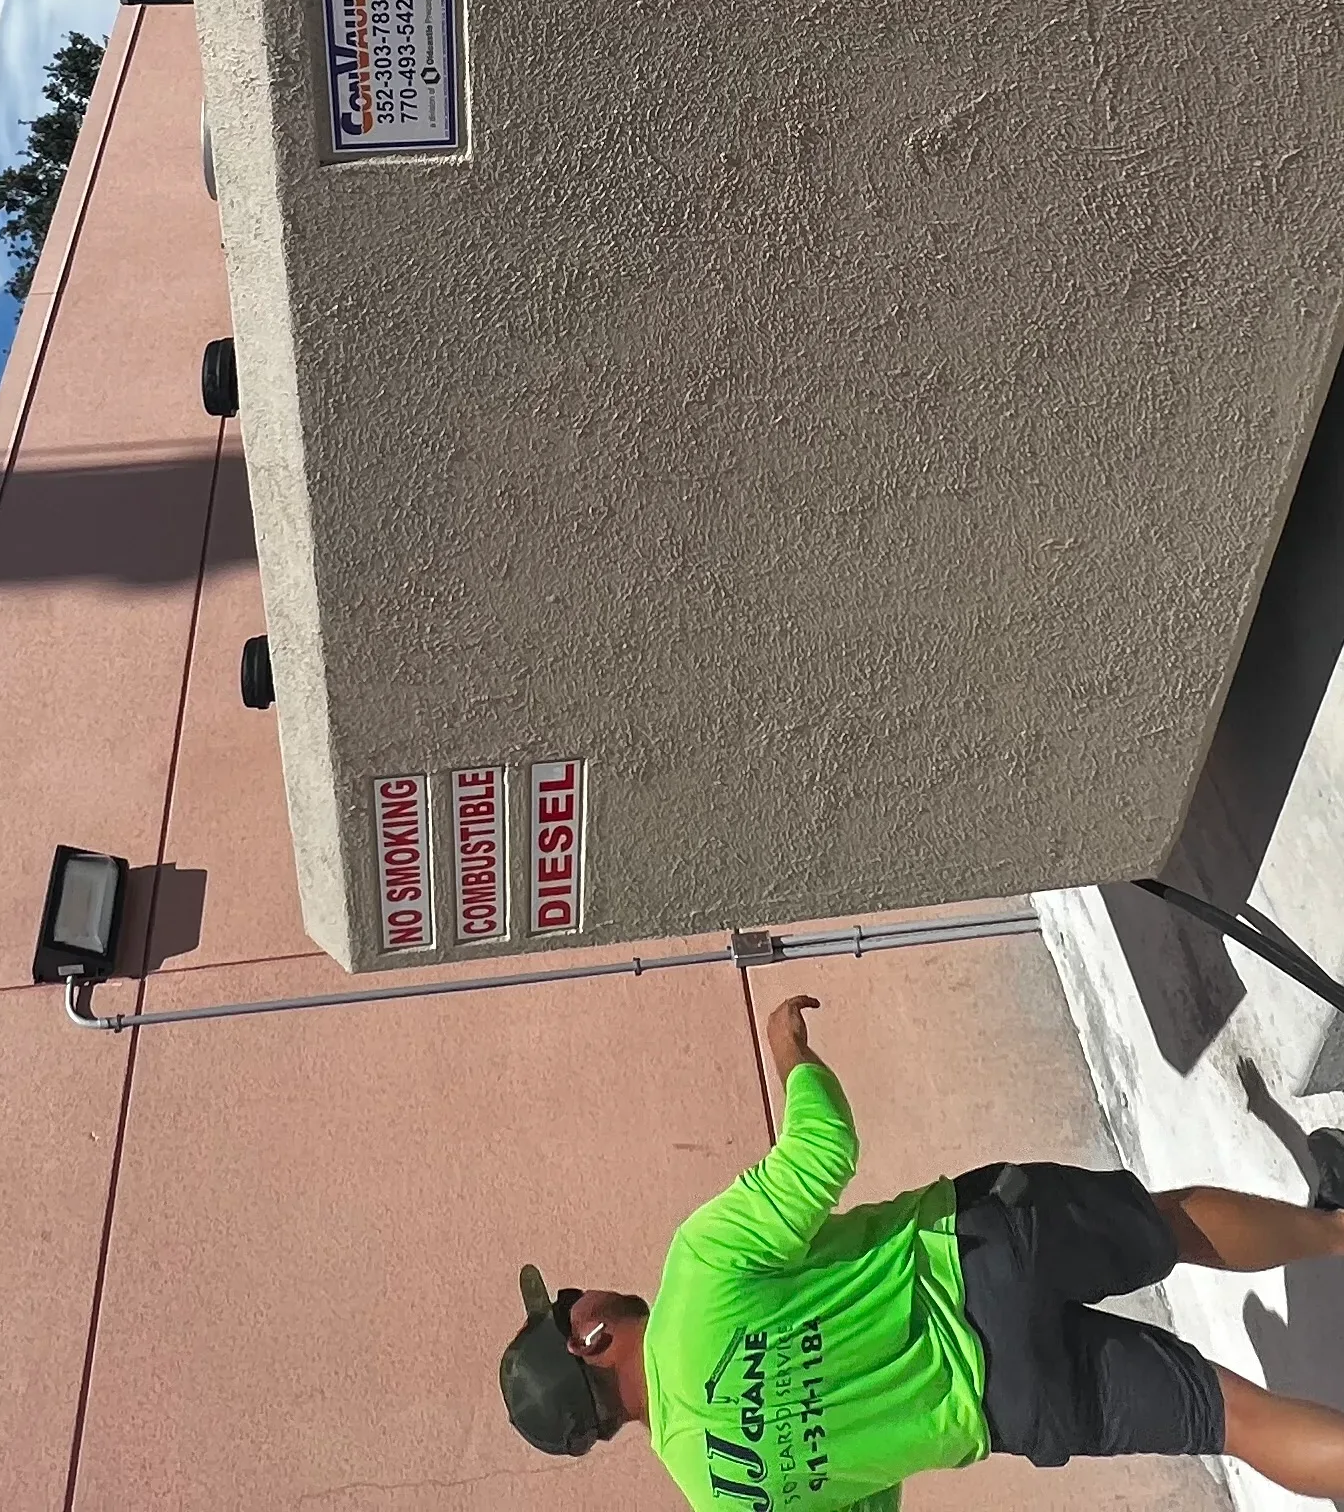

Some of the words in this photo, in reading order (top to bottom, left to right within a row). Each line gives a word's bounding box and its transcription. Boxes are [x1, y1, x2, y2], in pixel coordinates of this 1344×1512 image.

[380, 779, 422, 902] SMOKING
[458, 770, 497, 935] COMBUSTIBLE
[537, 763, 575, 928] DIESEL
[388, 909, 424, 945] NO
[740, 1331, 768, 1443] CRANE
